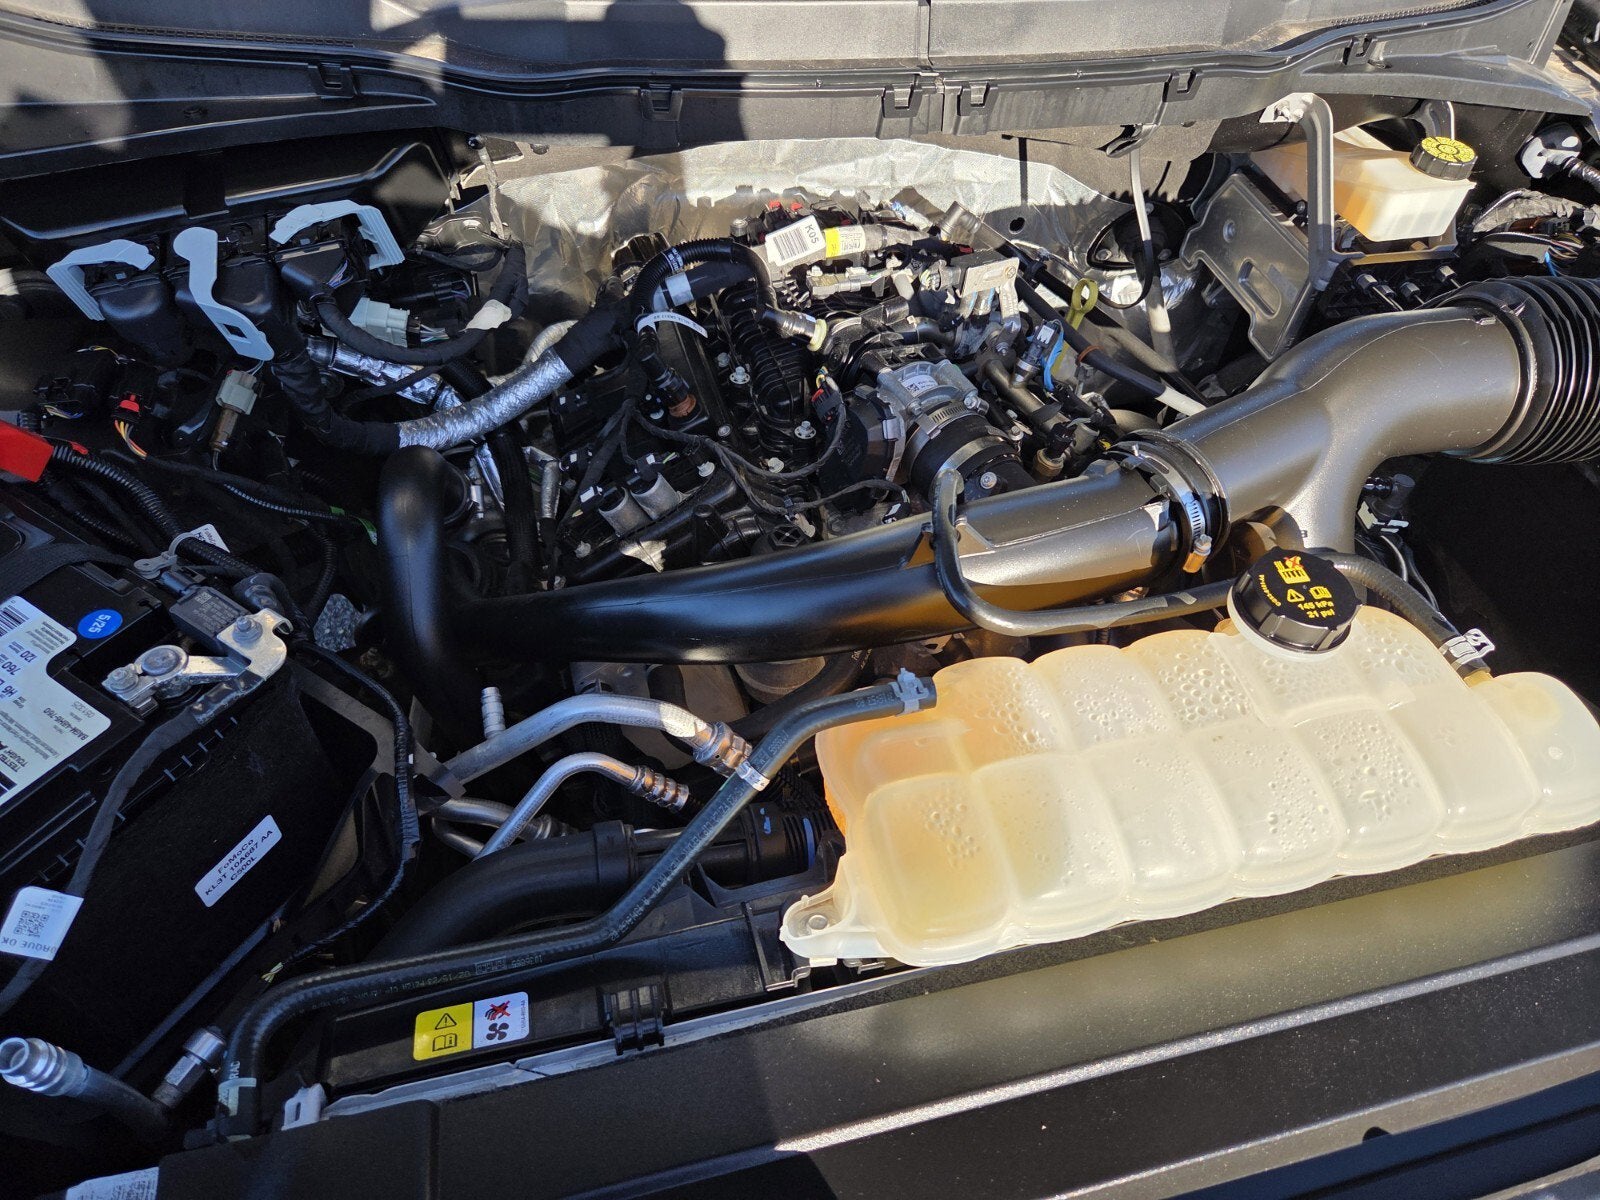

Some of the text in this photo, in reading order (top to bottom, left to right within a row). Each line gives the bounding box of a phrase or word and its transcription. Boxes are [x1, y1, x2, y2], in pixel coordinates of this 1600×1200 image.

[805, 224, 819, 244] K05
[1315, 600, 1334, 608] kPa
[1307, 608, 1335, 618] 21 psi
[88, 614, 111, 633] 5/25
[19, 649, 37, 662] 120
[1, 660, 20, 676] 760
[1, 684, 18, 697] H6
[205, 830, 273, 895] KL3T 10A687 AA
[218, 839, 254, 873] FoMoCo
[1, 937, 17, 945] OK
